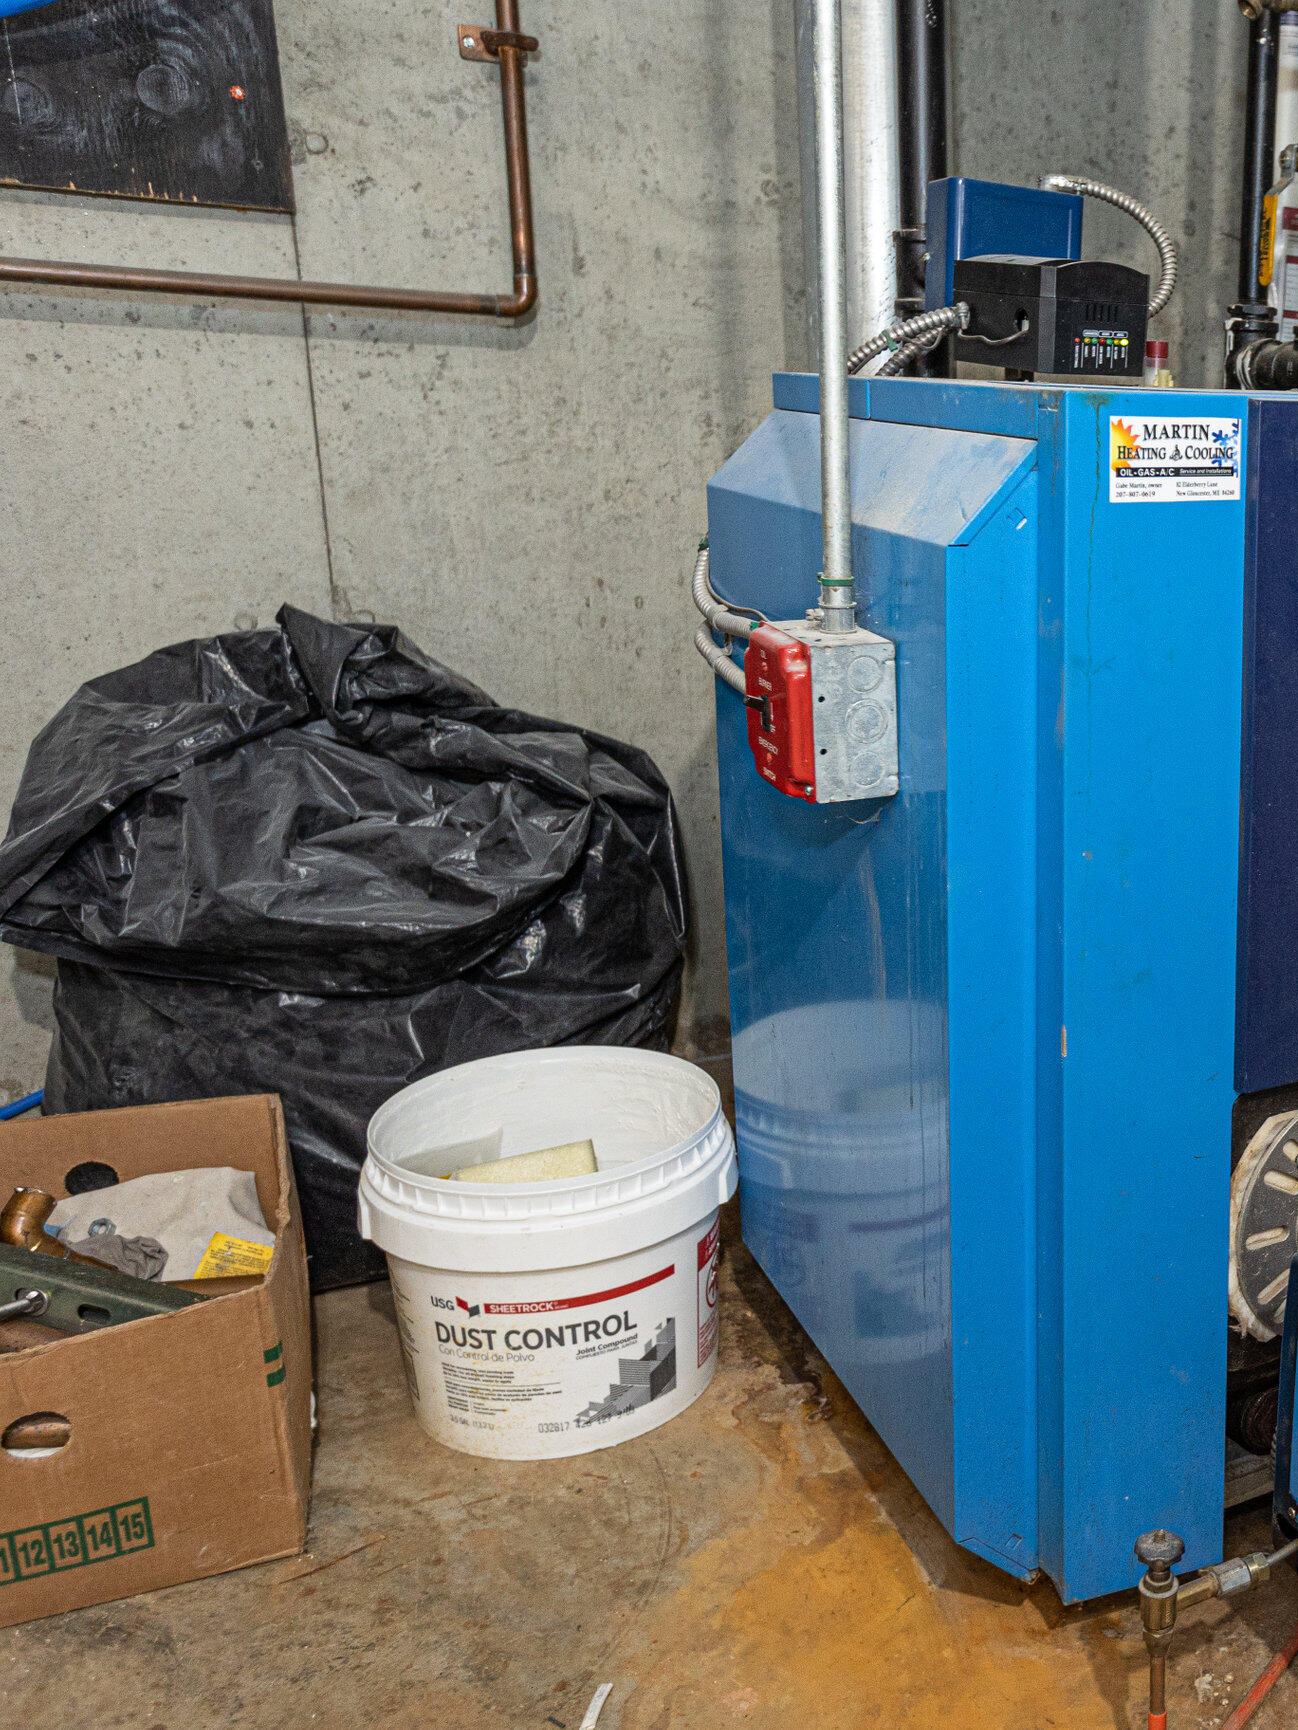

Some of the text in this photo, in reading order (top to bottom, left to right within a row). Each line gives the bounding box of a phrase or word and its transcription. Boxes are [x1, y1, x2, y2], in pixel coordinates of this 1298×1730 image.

[1143, 424, 1210, 441] MARTIN
[1117, 445, 1166, 460] HEATING
[1185, 445, 1234, 460] COOLING
[430, 1295, 455, 1311] USG
[489, 1302, 554, 1313] SHEETROCK
[435, 1310, 638, 1351] DUST CONTROL
[439, 1344, 456, 1357] Con
[506, 1351, 536, 1362] Polvo
[576, 1333, 639, 1356] Joint Compound
[19, 1539, 47, 1568] 12
[52, 1531, 80, 1559] 13
[86, 1521, 113, 1551] 14
[119, 1512, 146, 1542] 15
